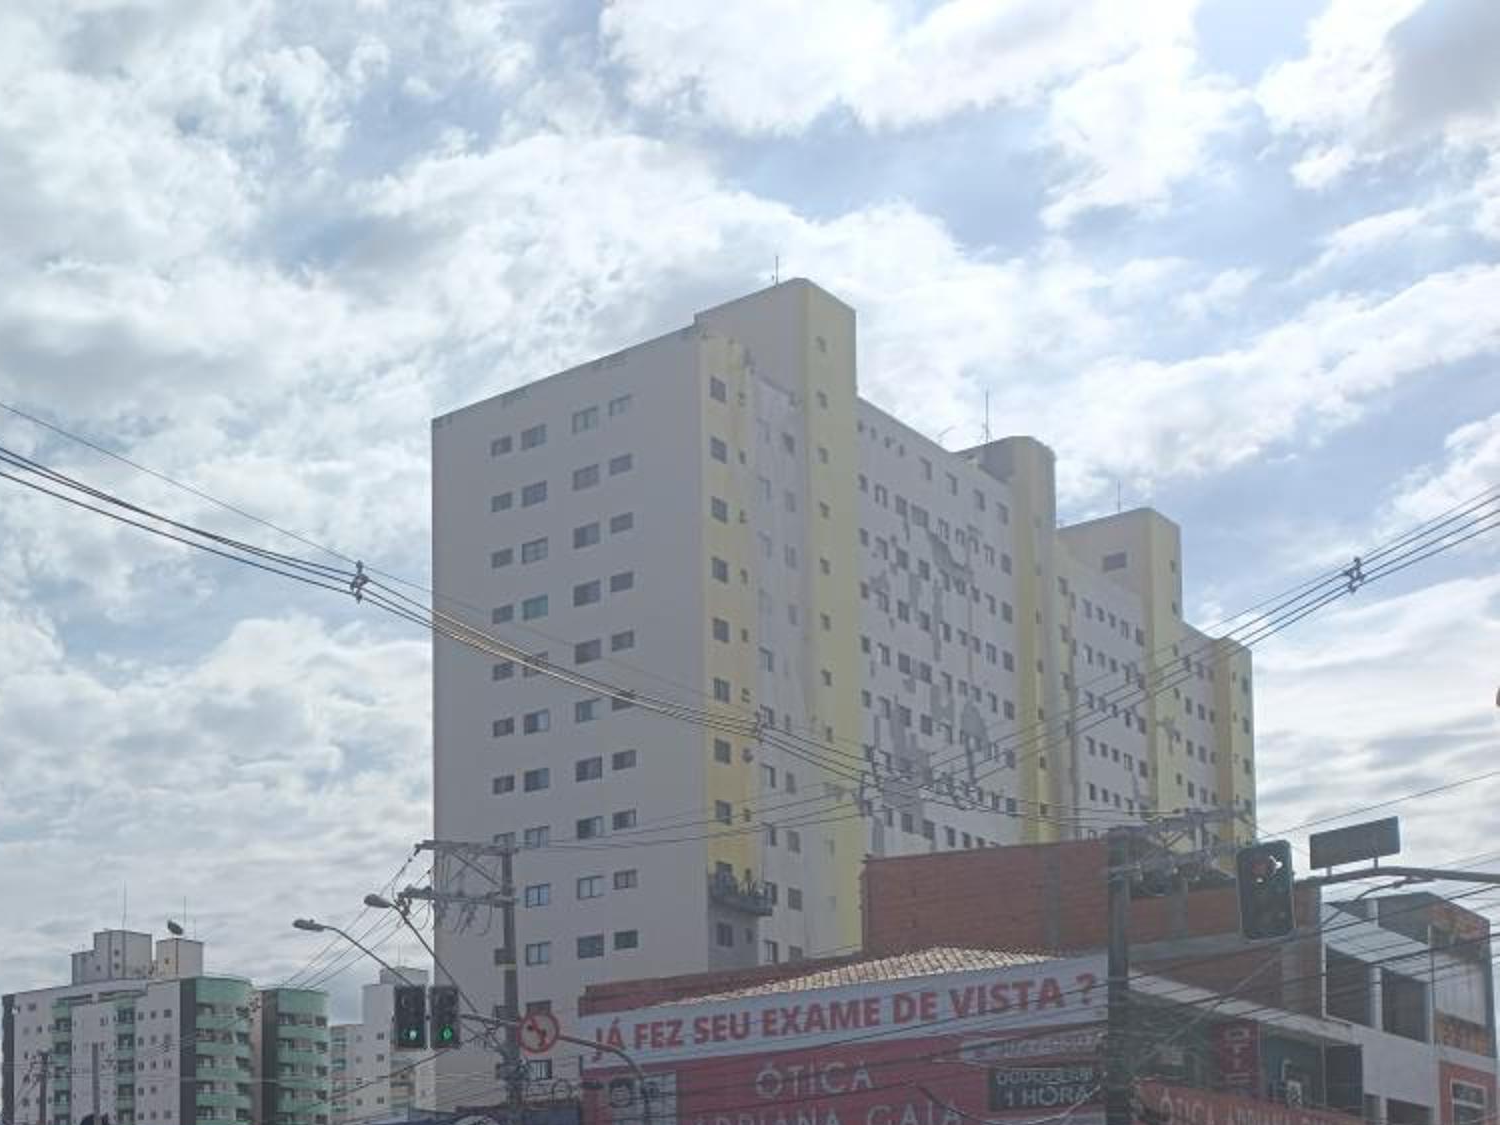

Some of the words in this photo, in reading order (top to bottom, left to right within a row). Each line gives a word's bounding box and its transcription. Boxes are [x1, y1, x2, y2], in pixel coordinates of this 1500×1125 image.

[592, 1017, 626, 1062] JÁ
[633, 1019, 684, 1050] FEZ
[694, 1011, 750, 1044] SEU
[761, 997, 881, 1037] EXAME
[892, 991, 938, 1025] DE
[948, 977, 1065, 1017] VISTA
[755, 1060, 873, 1099] ÓTICA
